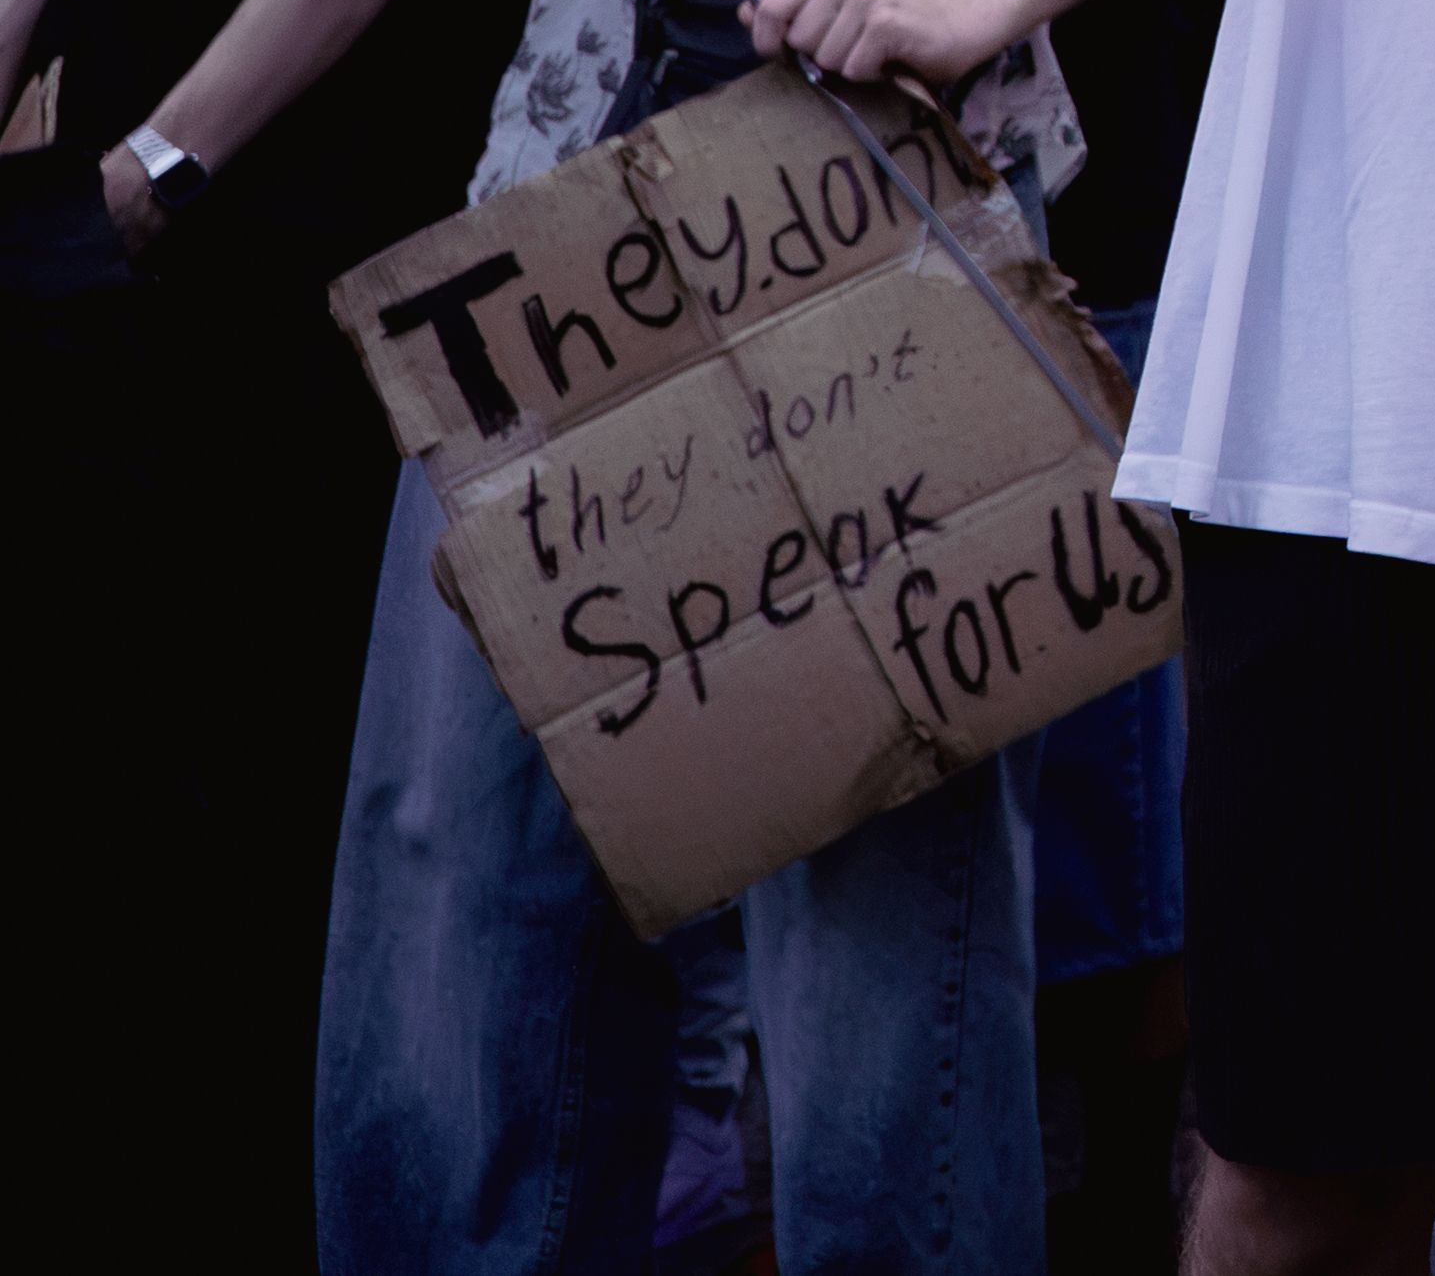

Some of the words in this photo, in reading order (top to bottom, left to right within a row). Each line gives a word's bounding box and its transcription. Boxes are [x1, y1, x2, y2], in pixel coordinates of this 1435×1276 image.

[519, 433, 694, 581] they
[745, 328, 923, 462] don't
[560, 471, 945, 739] Speak
[893, 566, 1039, 725] for
